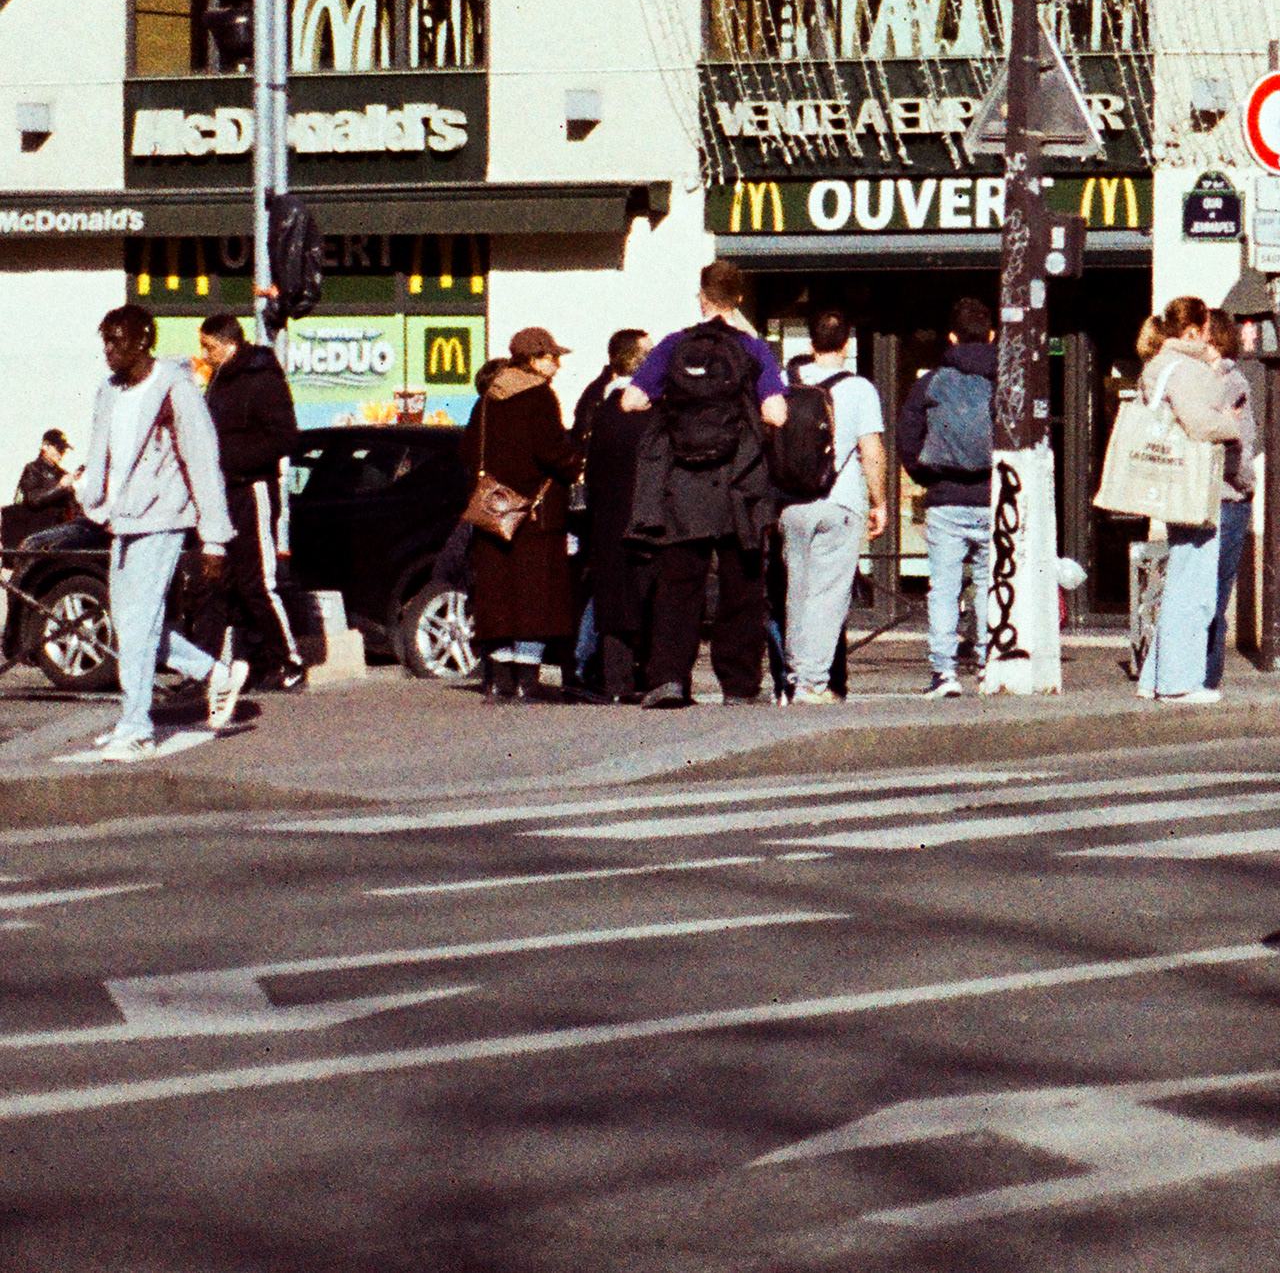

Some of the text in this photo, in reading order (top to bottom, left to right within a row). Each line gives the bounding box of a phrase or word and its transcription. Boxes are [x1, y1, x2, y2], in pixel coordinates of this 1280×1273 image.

[0, 208, 145, 233] McDonald's
[808, 177, 1055, 231] OUVER
[219, 232, 392, 269] OERT
[287, 341, 394, 375] McDUO
